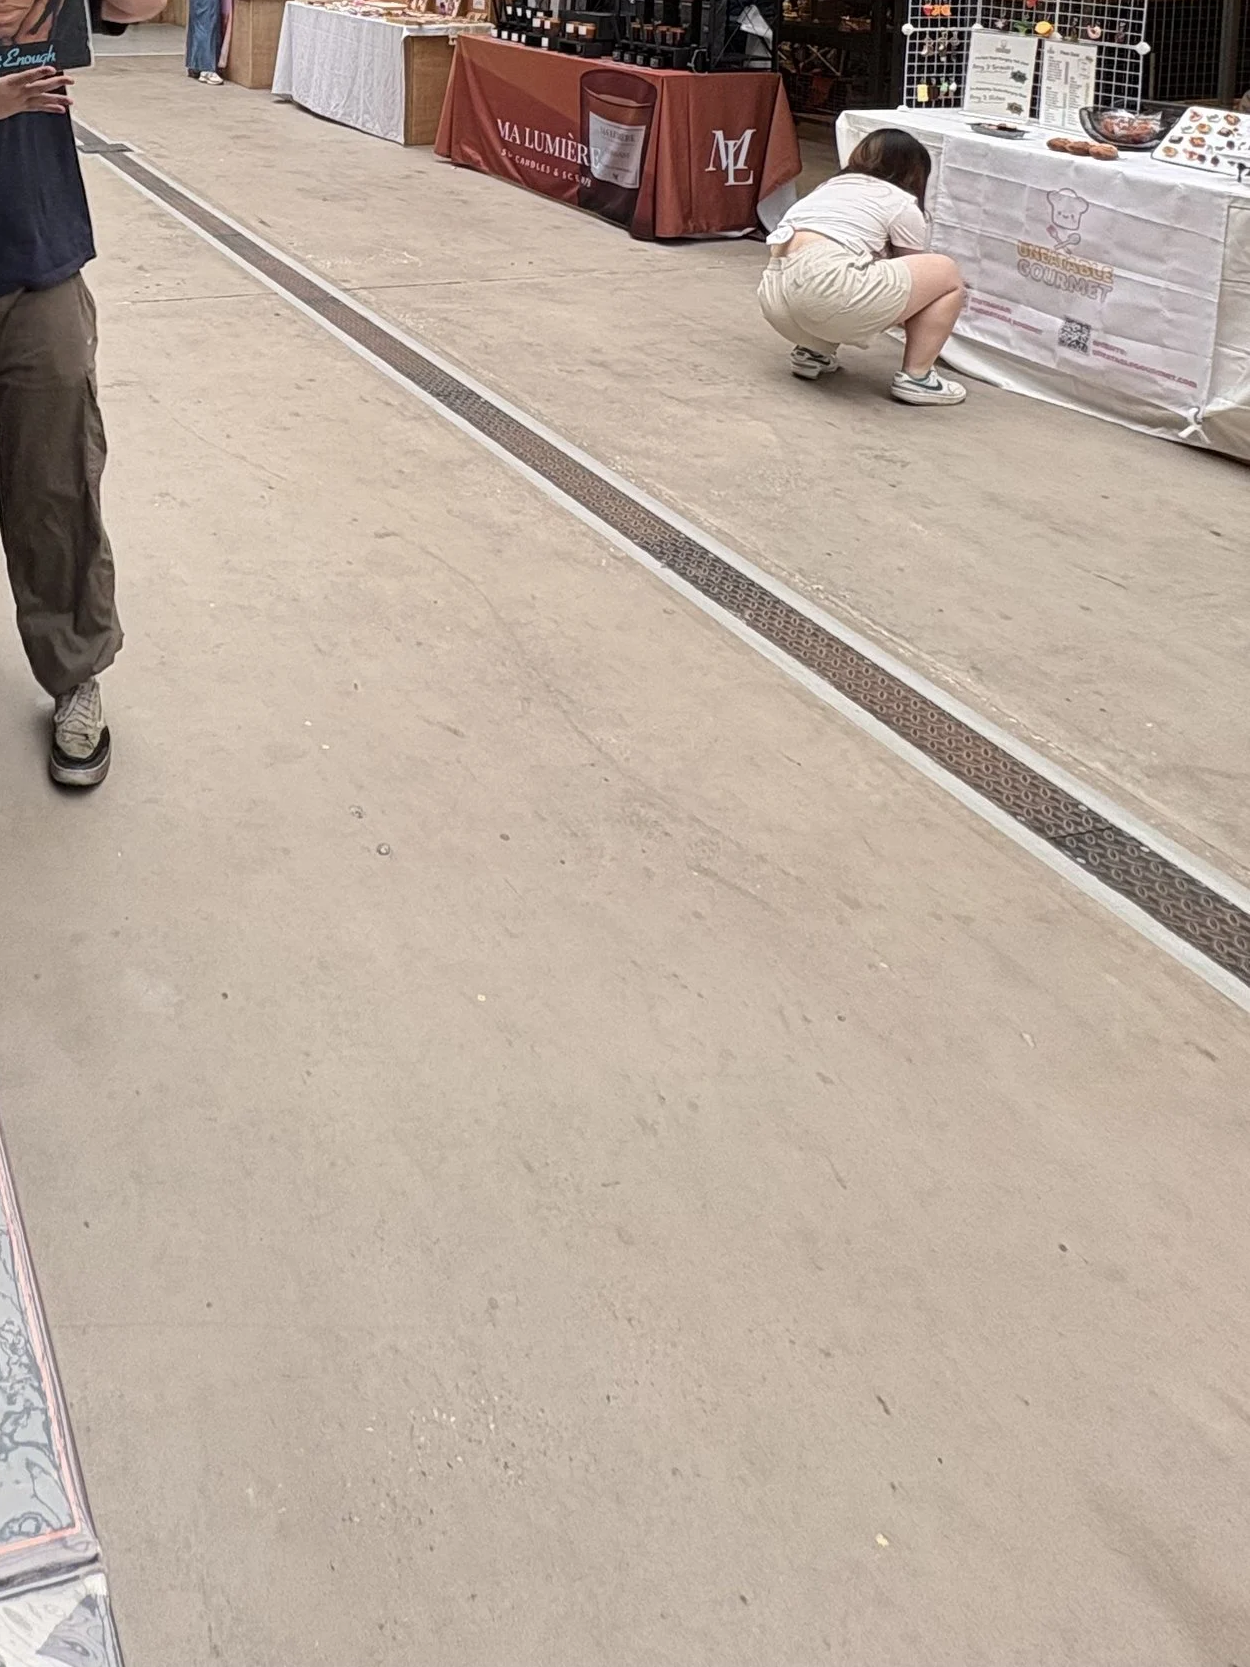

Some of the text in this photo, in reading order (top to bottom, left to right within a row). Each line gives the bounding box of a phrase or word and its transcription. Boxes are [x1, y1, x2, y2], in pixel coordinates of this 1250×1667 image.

[3, 44, 56, 68] Enough
[497, 118, 521, 145] MA
[525, 127, 601, 169] LUMIÈRE
[1017, 240, 1114, 283] UNEATABLE
[1017, 259, 1113, 302] GOURMET
